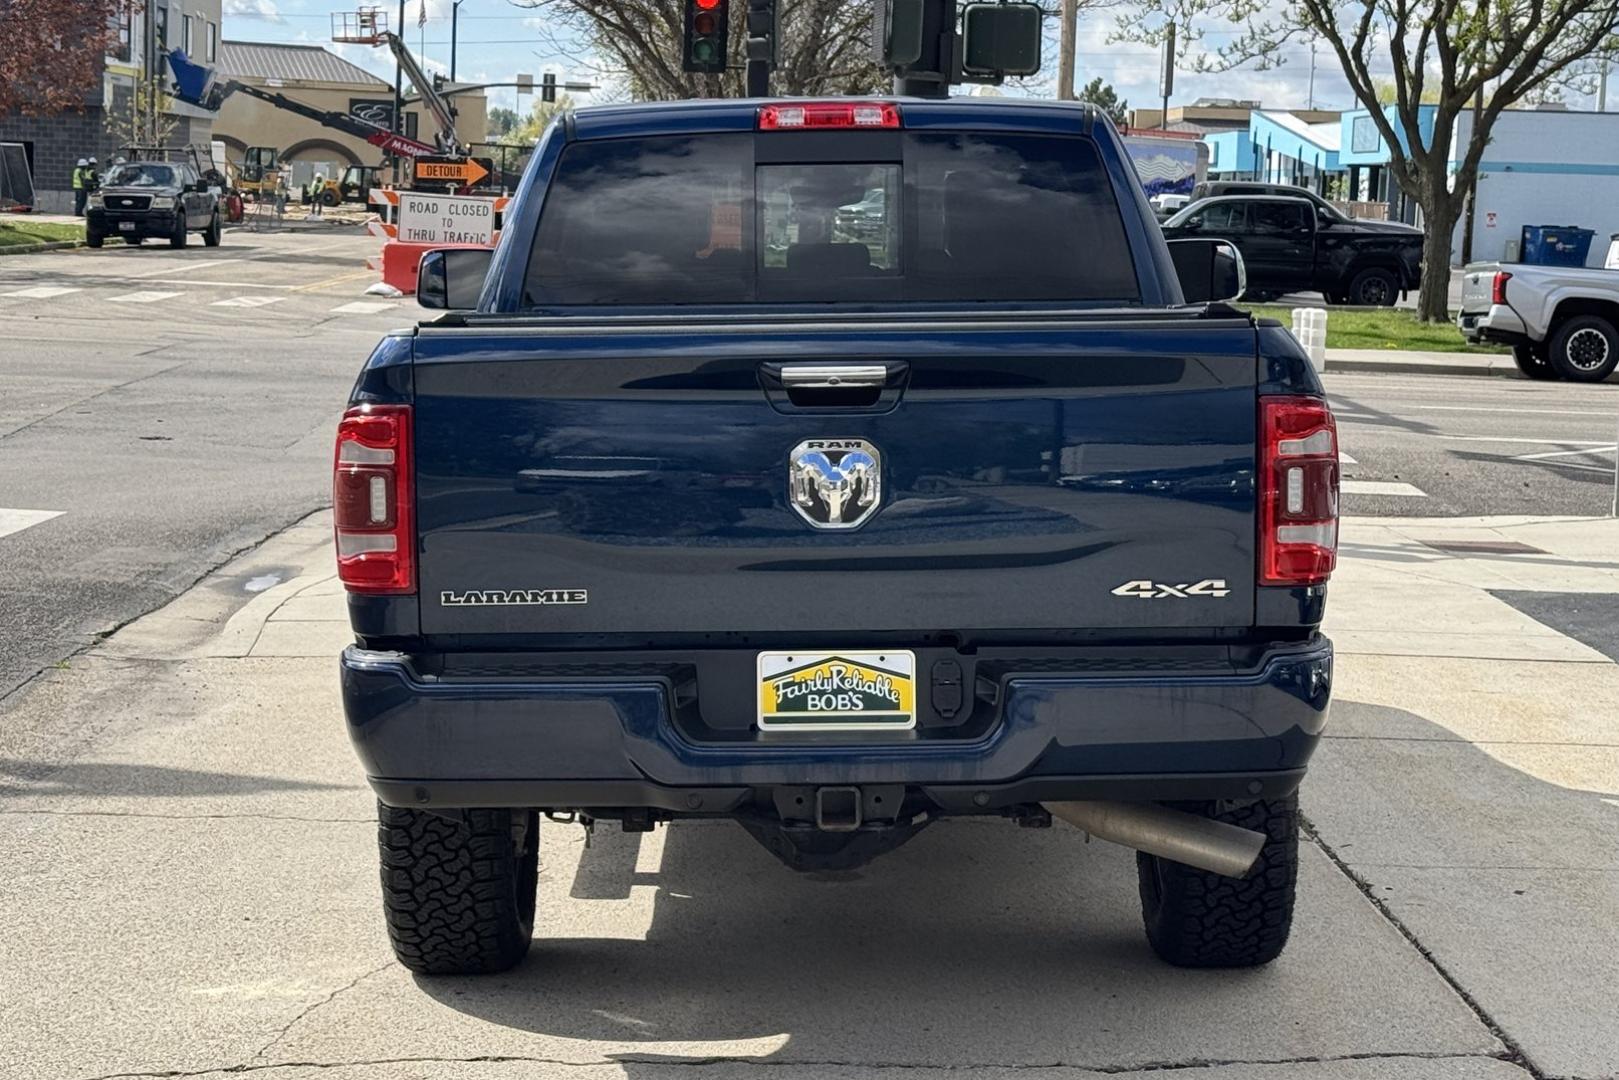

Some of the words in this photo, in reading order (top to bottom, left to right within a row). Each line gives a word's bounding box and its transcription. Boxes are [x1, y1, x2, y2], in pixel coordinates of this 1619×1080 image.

[426, 165, 462, 177] DETOUR
[409, 202, 438, 214] ROAD
[448, 204, 489, 217] CLOSED
[442, 218, 453, 228] TO
[407, 229, 436, 241] THRU
[443, 231, 486, 245] TRAFFIC
[1111, 579, 1231, 598] 4x4
[441, 589, 588, 606] LARAMIE
[773, 669, 833, 704] Fairly
[829, 665, 901, 703] Reliable
[807, 691, 864, 711] BOB'S
